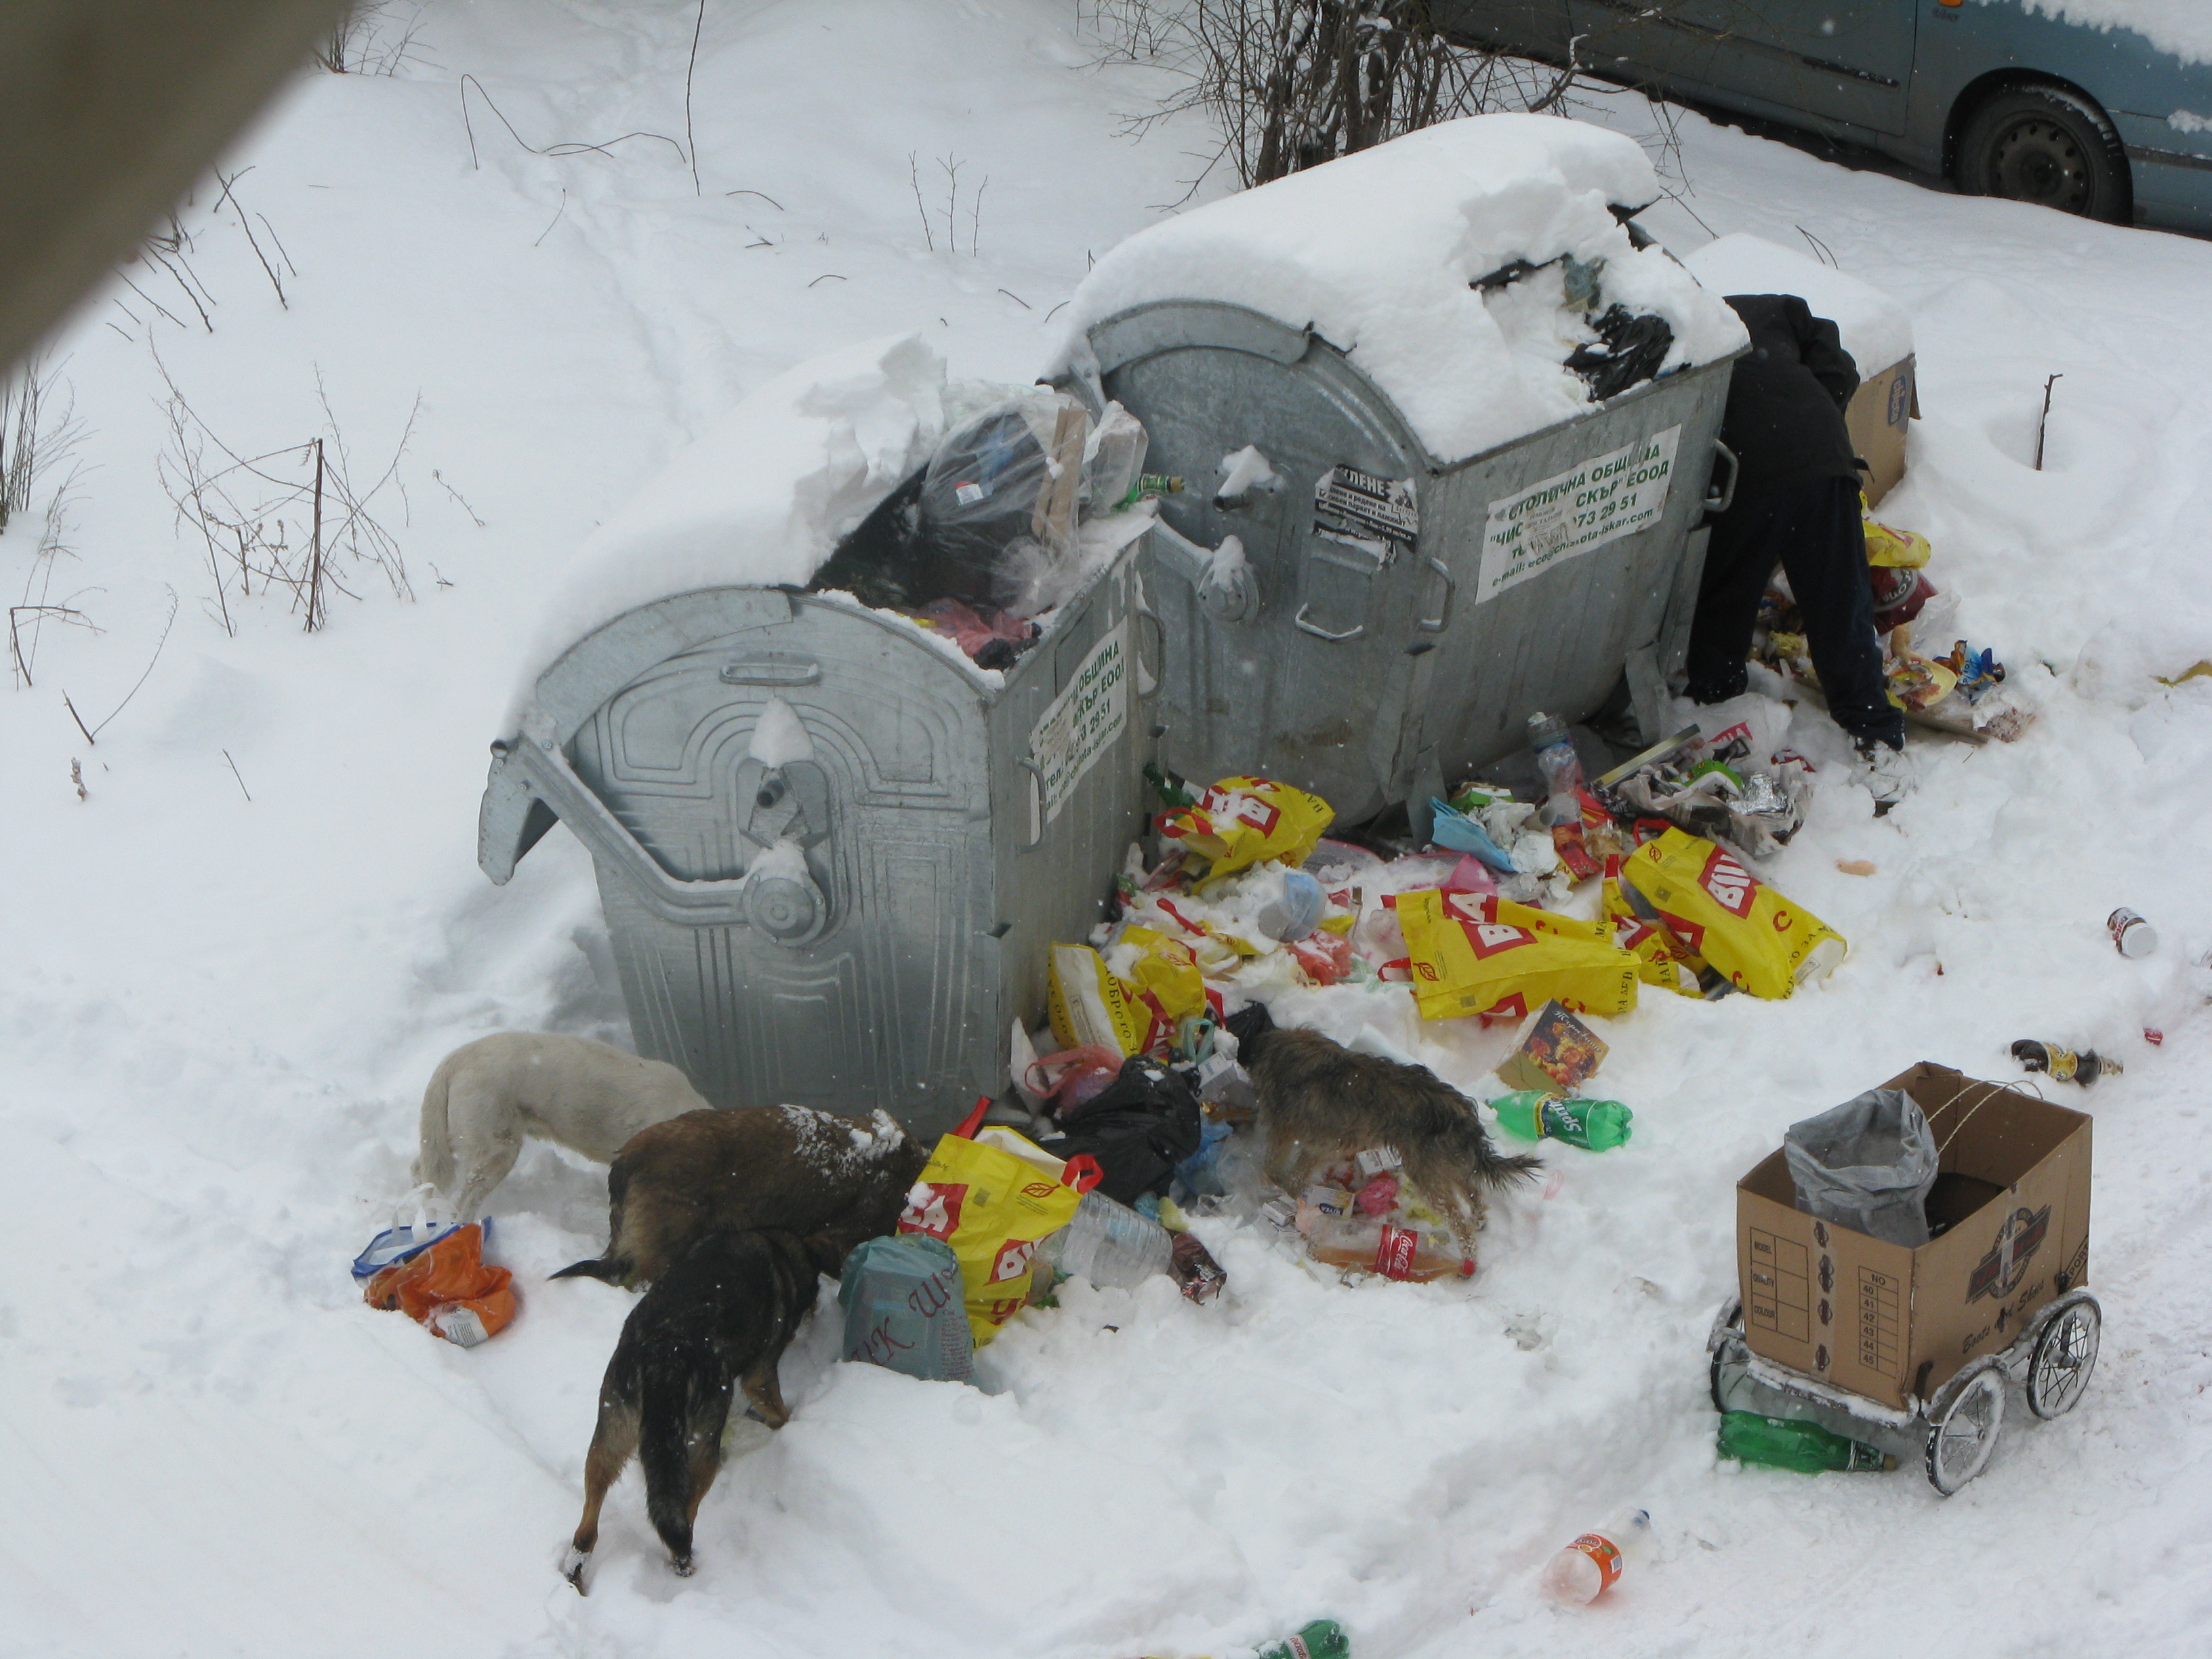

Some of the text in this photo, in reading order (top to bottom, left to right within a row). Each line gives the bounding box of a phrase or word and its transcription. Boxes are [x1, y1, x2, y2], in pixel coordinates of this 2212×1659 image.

[1626, 459, 1670, 488] ЕООД
[1600, 501, 1617, 521] 29
[1620, 493, 1637, 510] 51
[1079, 640, 1119, 692] ОБЩИНА
[1320, 1204, 1344, 1216] NIVEA
[1754, 1241, 1773, 1255] MODEL
[1753, 1273, 1775, 1288] QUALITY
[1871, 1273, 1886, 1286] NO
[1863, 1284, 1875, 1295] 40
[1863, 1298, 1875, 1309] 41
[1754, 1305, 1776, 1319] COLOUR
[1863, 1312, 1875, 1322] 42
[1863, 1326, 1875, 1338] 43
[1863, 1339, 1875, 1351] 44
[1963, 1325, 1991, 1354] Boots
[1863, 1354, 1875, 1366] 45
